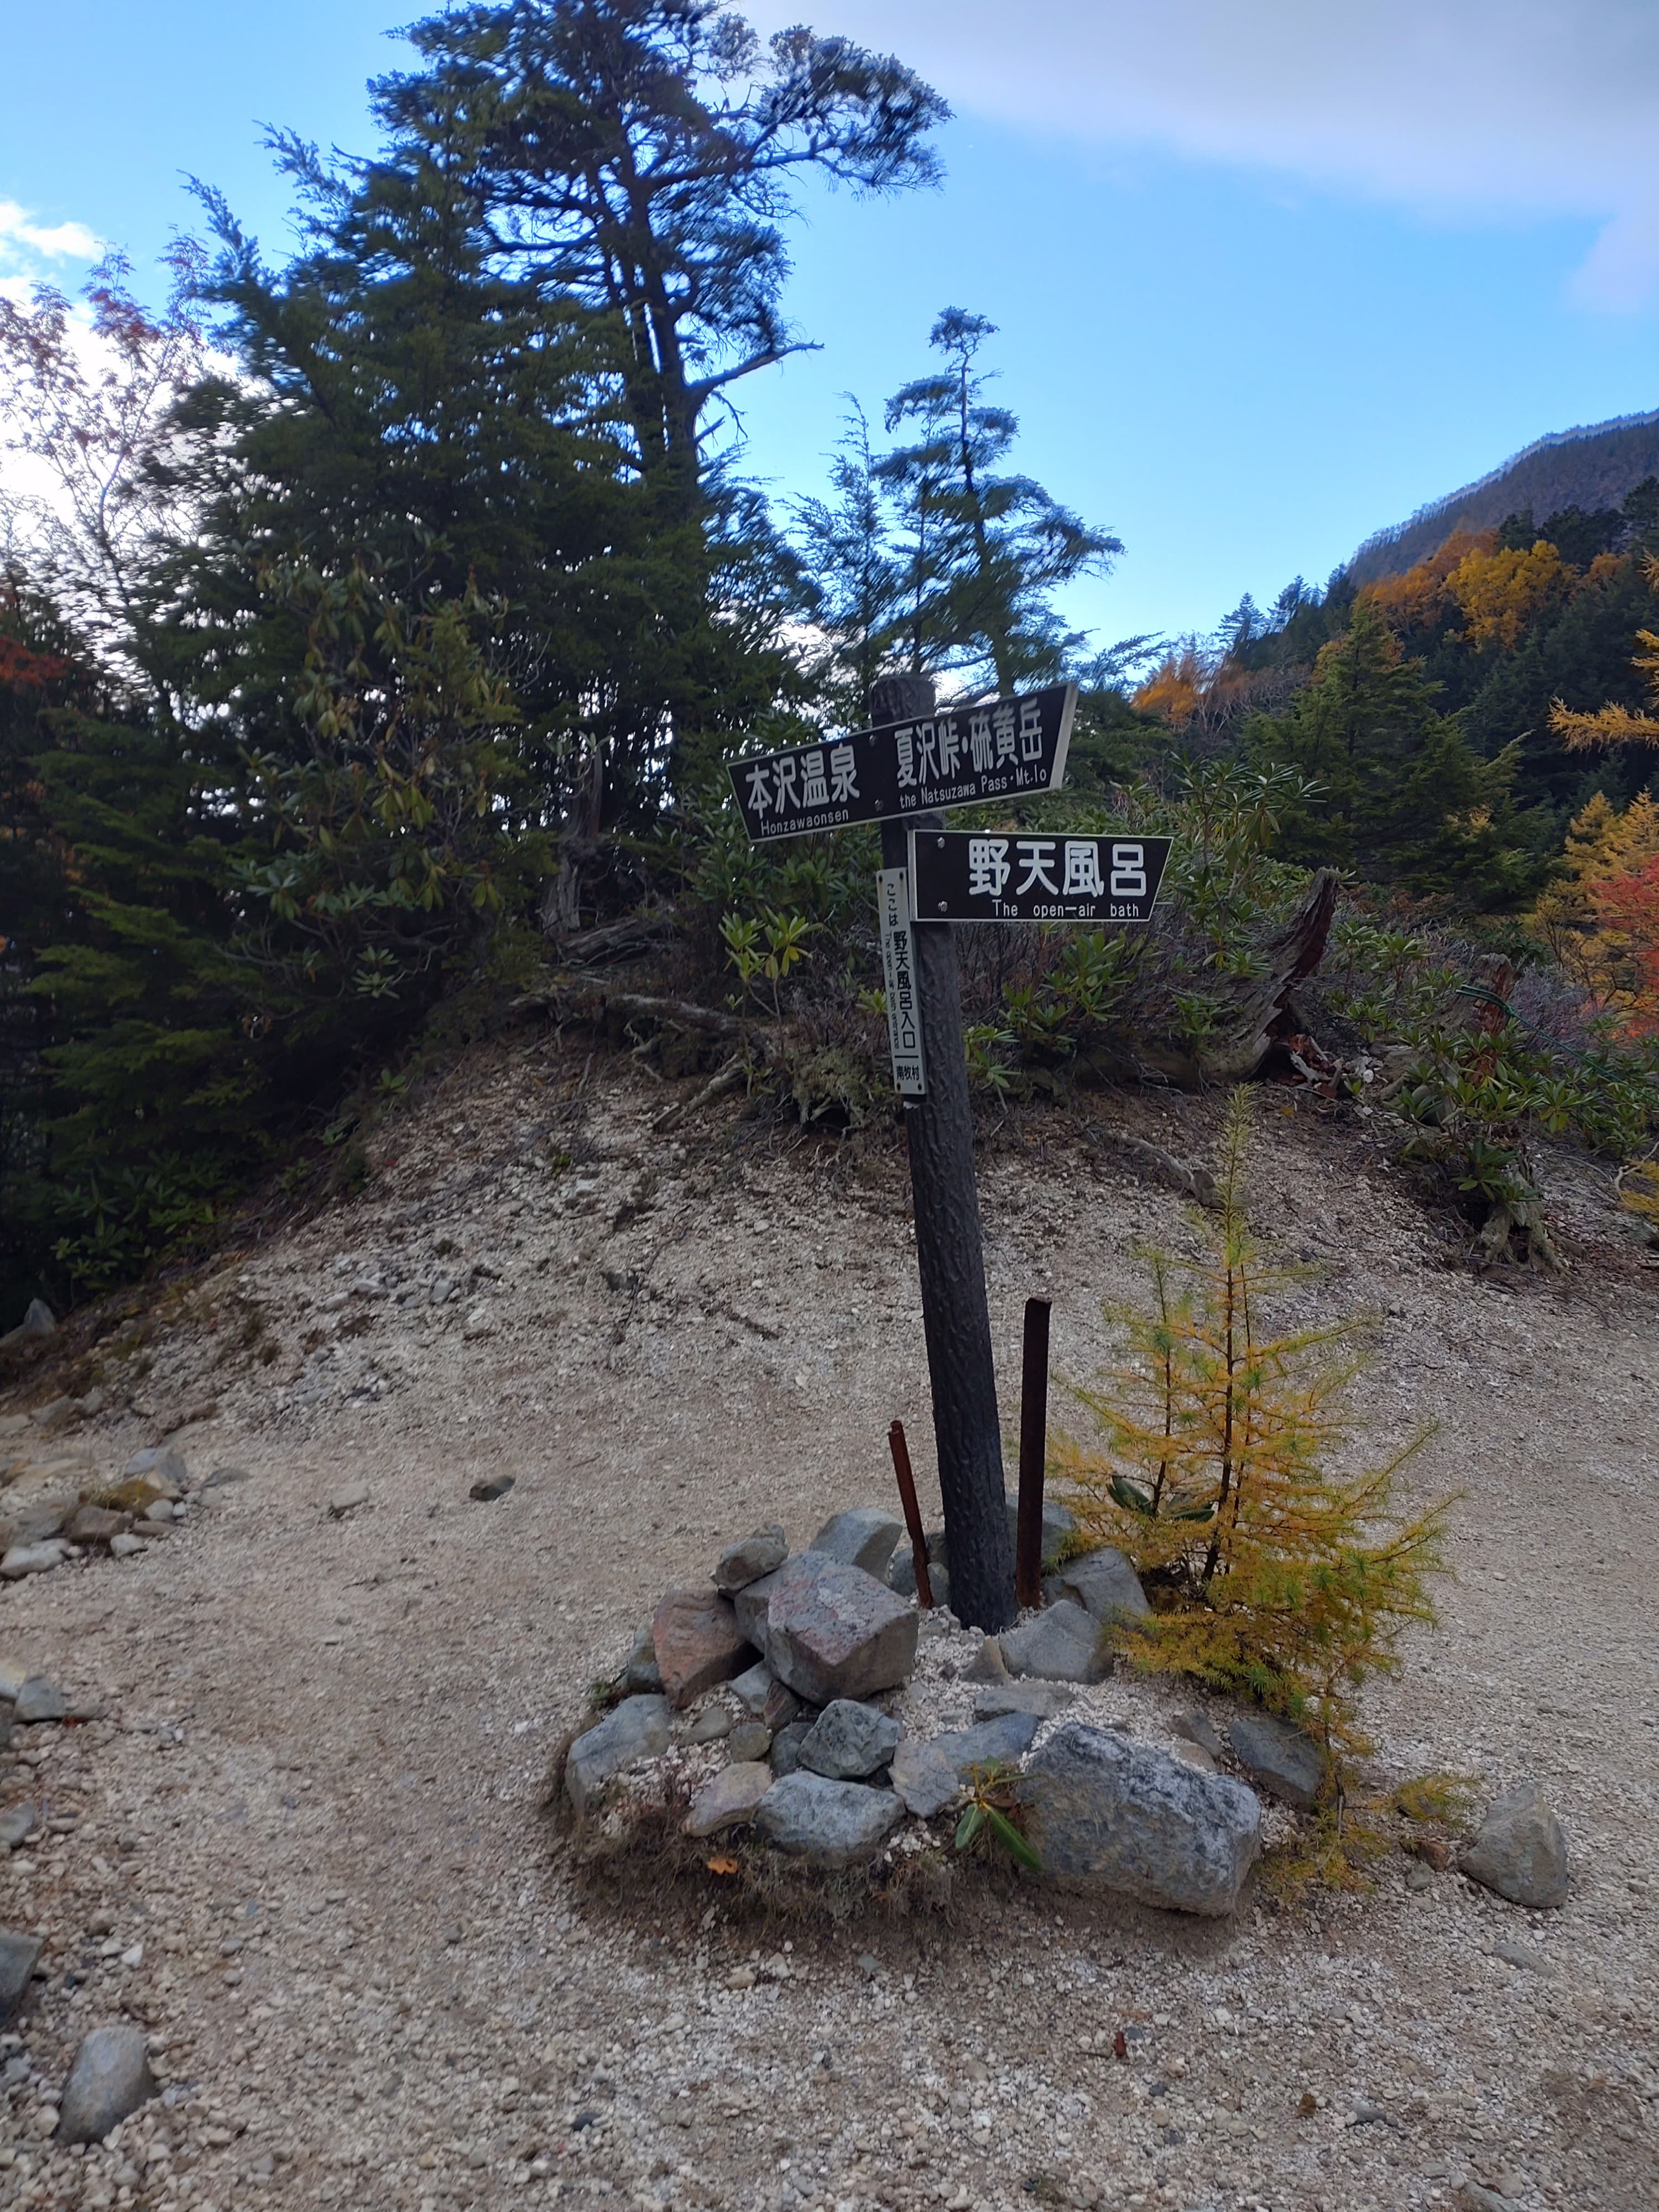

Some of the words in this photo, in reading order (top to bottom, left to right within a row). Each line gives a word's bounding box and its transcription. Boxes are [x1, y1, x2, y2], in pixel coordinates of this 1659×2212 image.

[746, 743, 860, 820] 本沢温泉
[899, 792, 917, 810] the
[921, 782, 976, 805] Natsuzawa
[760, 809, 849, 836] Honzawaonsen
[968, 838, 1147, 898] 野天風呂
[992, 899, 1018, 916] The
[1033, 902, 1096, 919] open-air
[1110, 902, 1139, 917] bath
[896, 1065, 920, 1081] 南牧村
